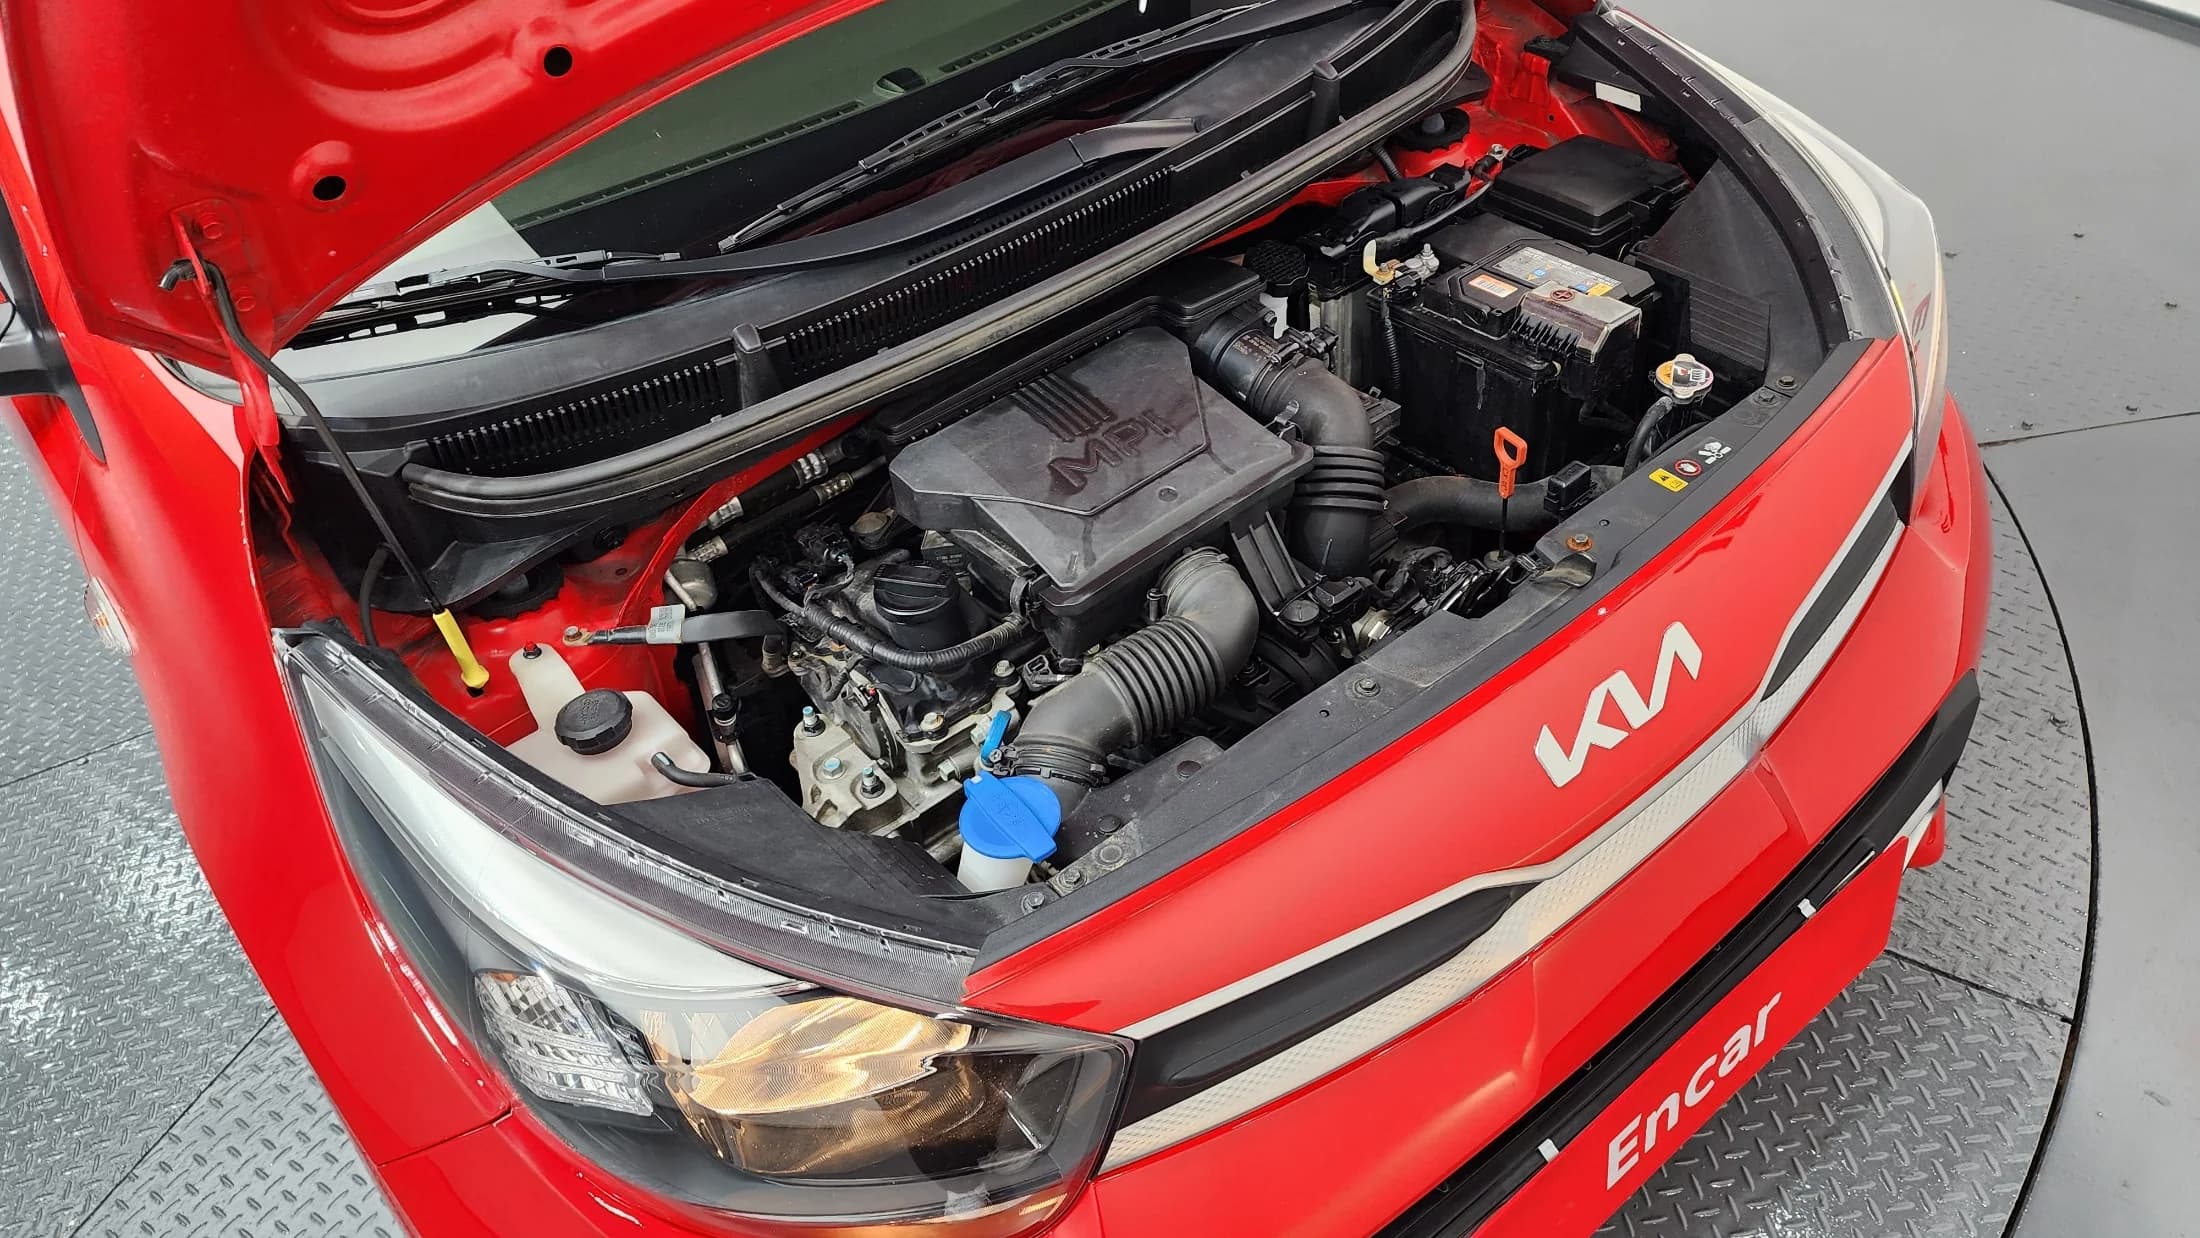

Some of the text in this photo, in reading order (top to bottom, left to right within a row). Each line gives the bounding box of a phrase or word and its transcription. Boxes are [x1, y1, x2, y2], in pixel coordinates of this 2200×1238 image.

[1048, 411, 1176, 488] MPI
[1535, 621, 1702, 788] KIA
[1606, 991, 1782, 1191] Encar
